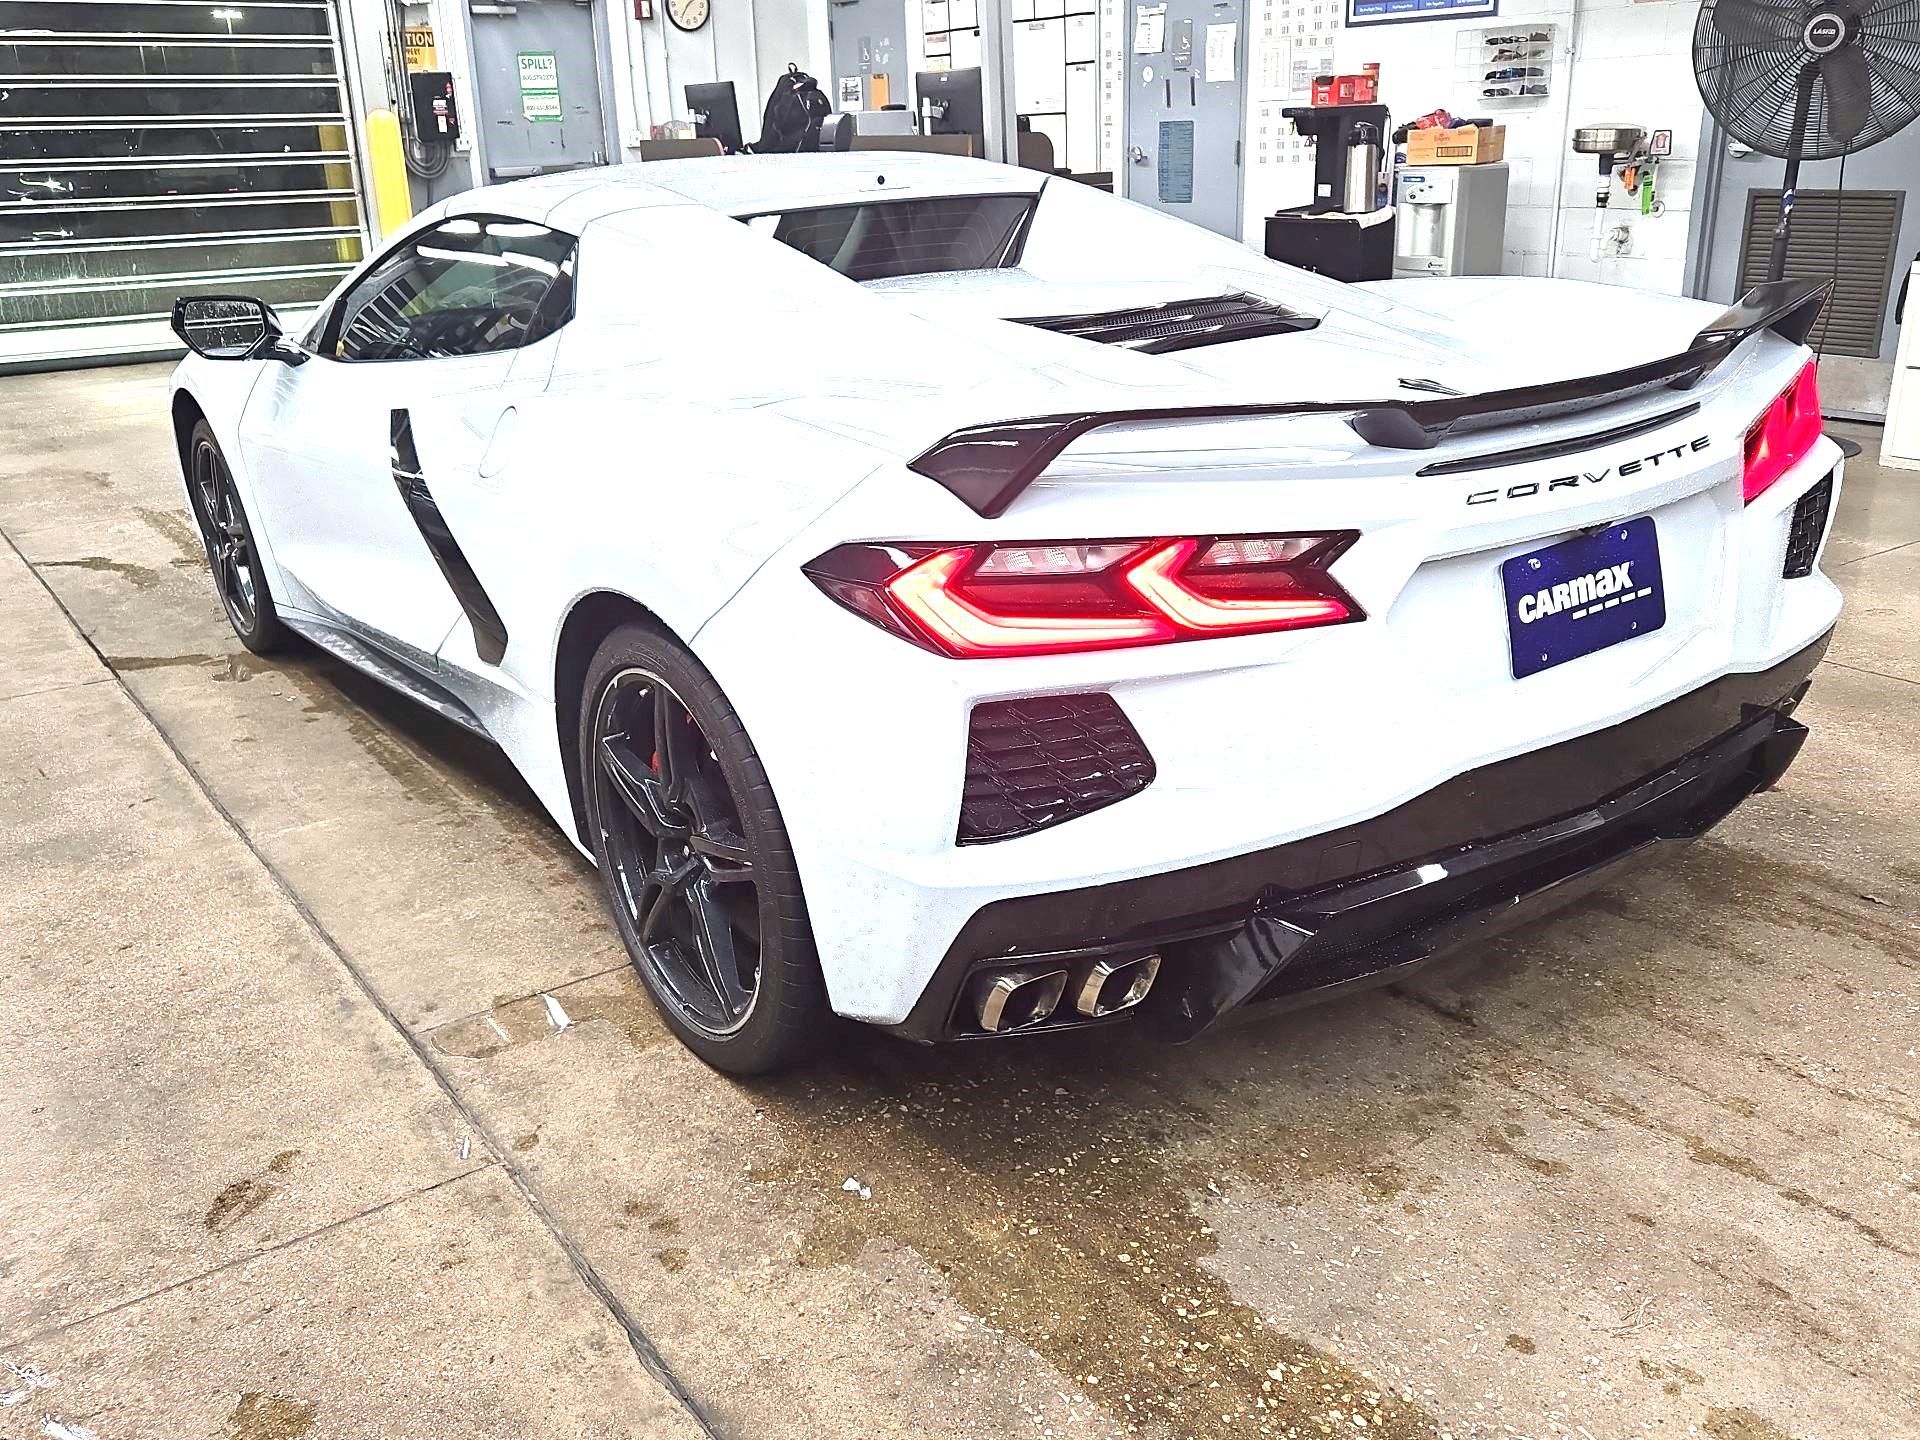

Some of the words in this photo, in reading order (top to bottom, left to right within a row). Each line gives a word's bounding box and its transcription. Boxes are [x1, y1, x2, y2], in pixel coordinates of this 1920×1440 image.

[405, 33, 434, 46] TION
[521, 58, 553, 70] SPILL?
[1466, 435, 1711, 505] CORVETTE
